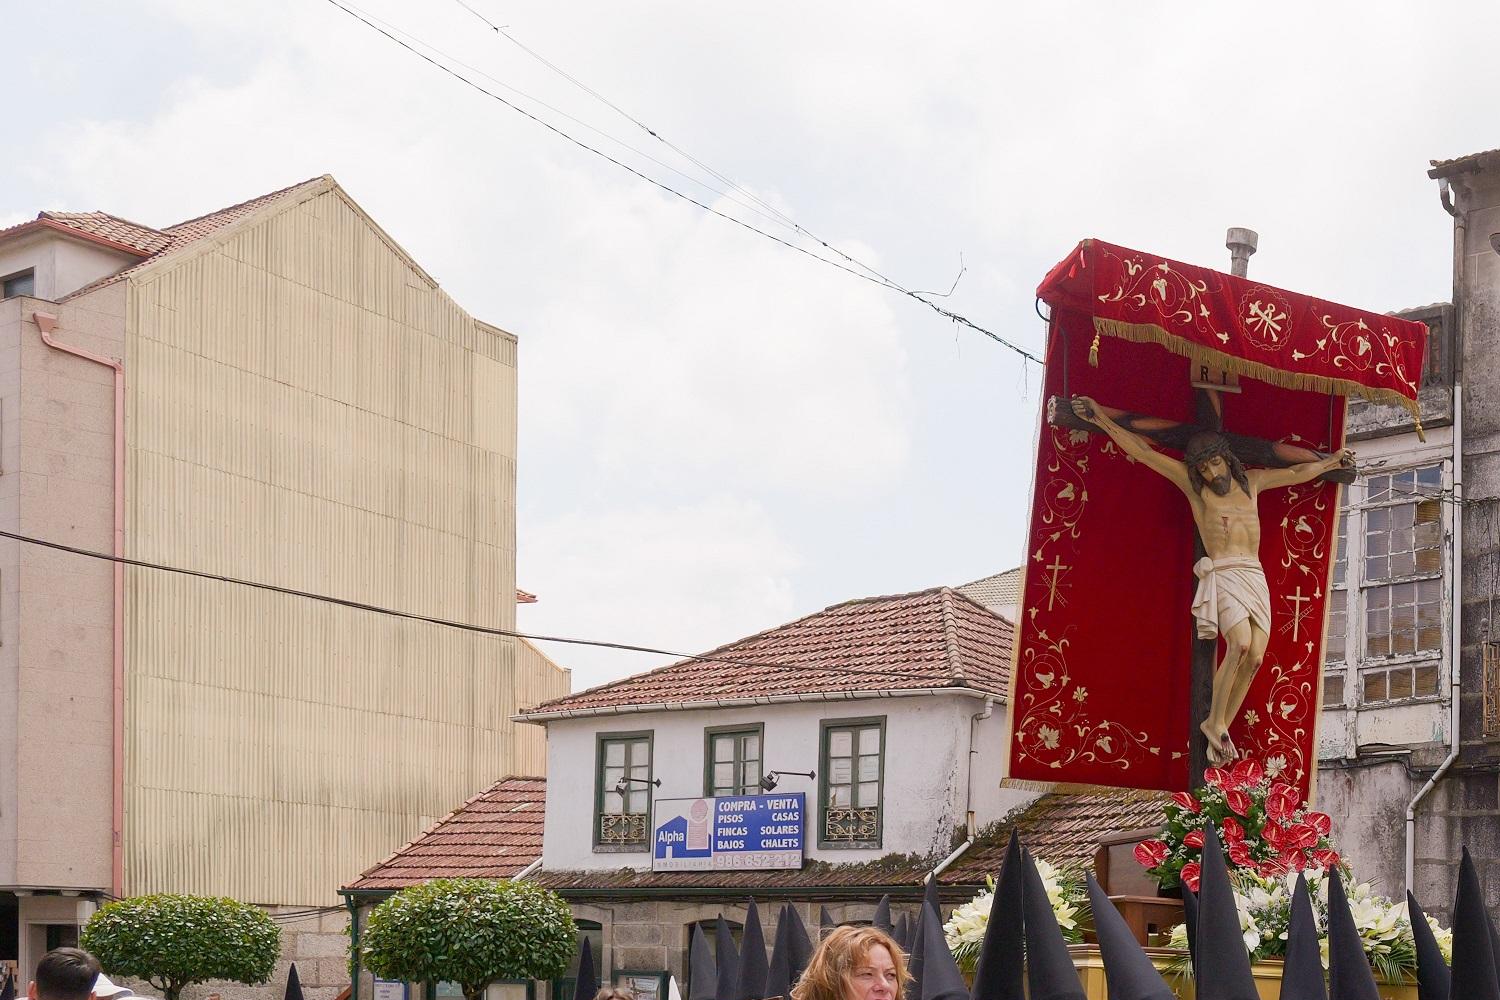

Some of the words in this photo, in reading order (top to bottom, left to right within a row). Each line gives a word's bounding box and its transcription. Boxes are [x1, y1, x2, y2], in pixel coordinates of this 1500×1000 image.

[719, 800, 756, 812] COMPRA
[767, 799, 799, 810] VENTA
[718, 814, 744, 823] PISOS
[772, 811, 799, 822] CASAS
[718, 826, 748, 836] FINCAS
[760, 825, 799, 835] SOLARES
[658, 830, 685, 845] Alpha
[717, 840, 745, 849] BAJOS
[761, 838, 799, 848] CHALETS
